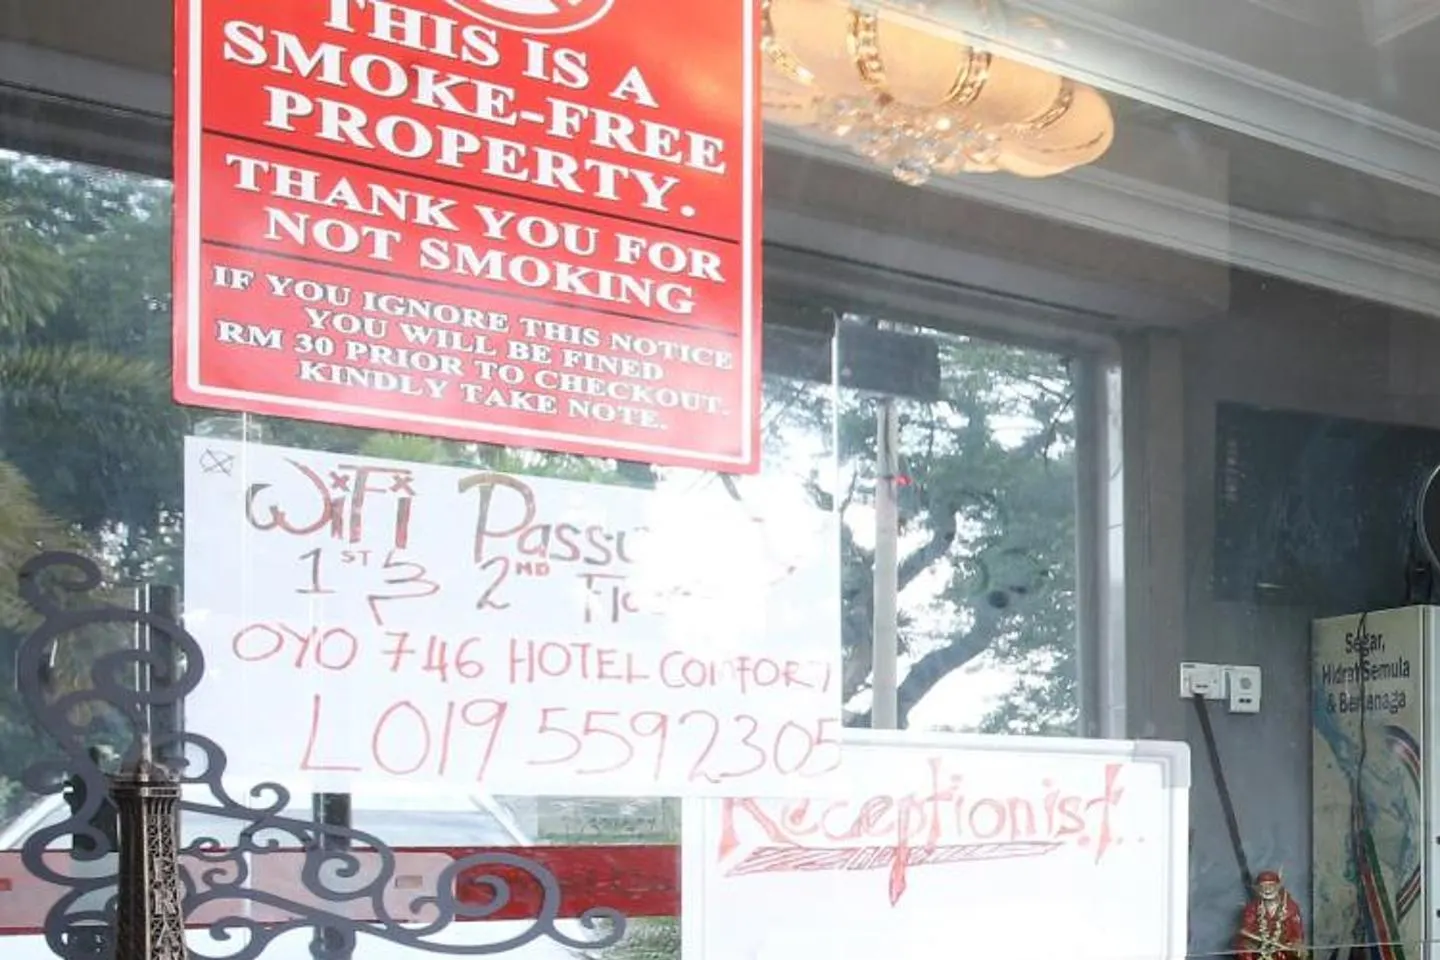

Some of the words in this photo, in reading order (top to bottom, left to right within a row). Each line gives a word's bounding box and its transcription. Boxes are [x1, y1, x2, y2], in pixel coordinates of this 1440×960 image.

[223, 21, 728, 174] SMOKE-FREE
[323, 0, 500, 67] THIS
[522, 38, 590, 90] IS
[608, 65, 659, 108] A
[263, 86, 697, 217] PROPERTY.
[225, 153, 460, 231] THANK
[474, 204, 599, 256] YOU
[615, 232, 726, 283] FOR
[264, 207, 402, 262] NOT
[420, 237, 696, 314] SMOKING
[213, 265, 254, 290] IF
[266, 273, 352, 307] YOU
[363, 291, 508, 333] IGNORE
[520, 317, 600, 347] THIS
[611, 332, 733, 370] NOTICE
[217, 320, 283, 349] RM
[295, 333, 334, 356] 30
[345, 340, 464, 375] PRIOR
[474, 360, 524, 385] TO
[535, 369, 731, 416] CHECKOUT.
[305, 307, 388, 338] YOU
[400, 322, 497, 356] WILL
[507, 340, 552, 364] BE
[561, 349, 664, 381] FINED
[299, 360, 448, 398] KINDLY
[460, 383, 557, 415] TAKE
[568, 400, 668, 430] NOTE.
[232, 622, 358, 671] OYO
[380, 630, 485, 682] 746
[508, 637, 649, 684] HOTEL
